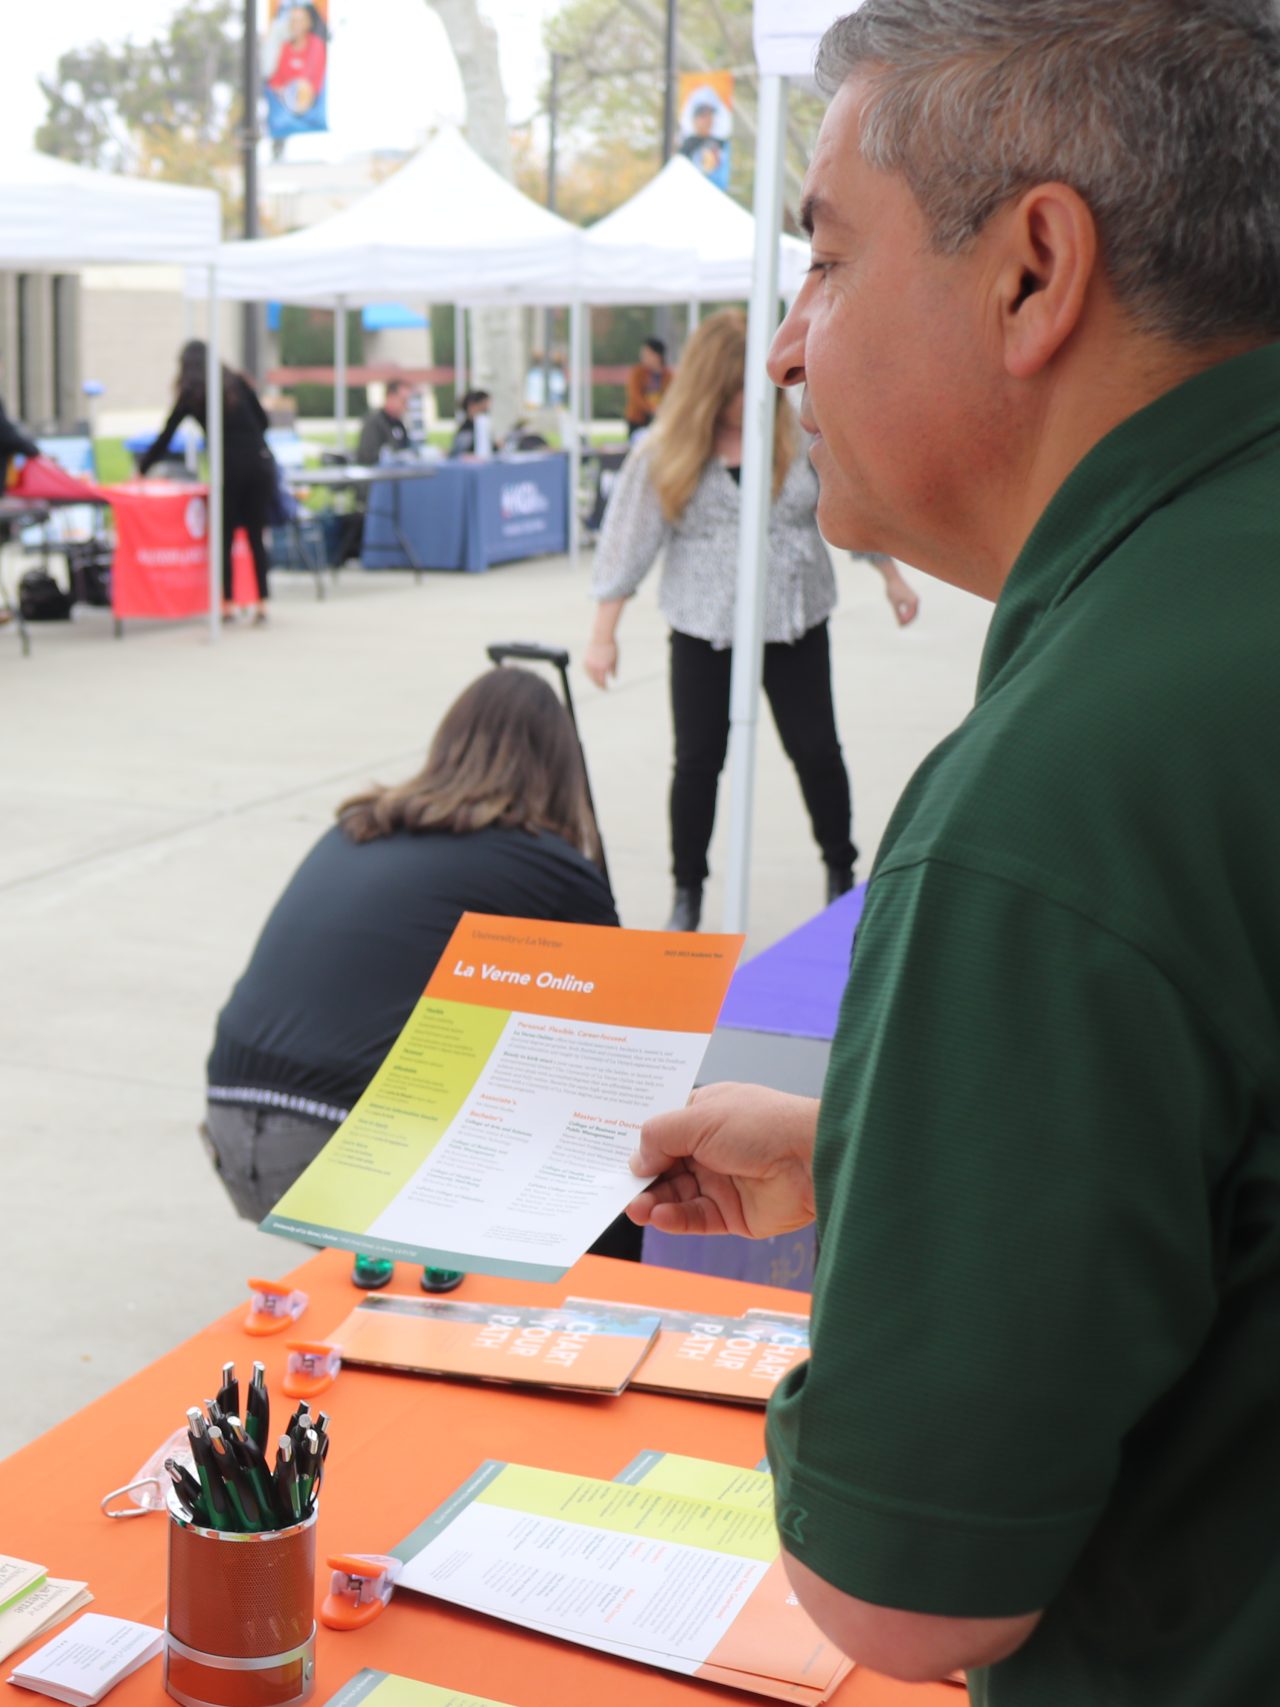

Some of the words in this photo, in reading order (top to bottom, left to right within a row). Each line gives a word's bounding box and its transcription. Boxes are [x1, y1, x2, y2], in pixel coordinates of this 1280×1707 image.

[453, 960, 475, 978] La
[481, 963, 531, 986] Verne
[536, 971, 595, 994] Online
[473, 1313, 520, 1350] PATH
[510, 1319, 560, 1357] YOUR
[544, 1320, 597, 1367] CHART
[677, 1321, 724, 1361] PATH
[713, 1328, 764, 1371] YOUR
[752, 1331, 805, 1382] CHART
